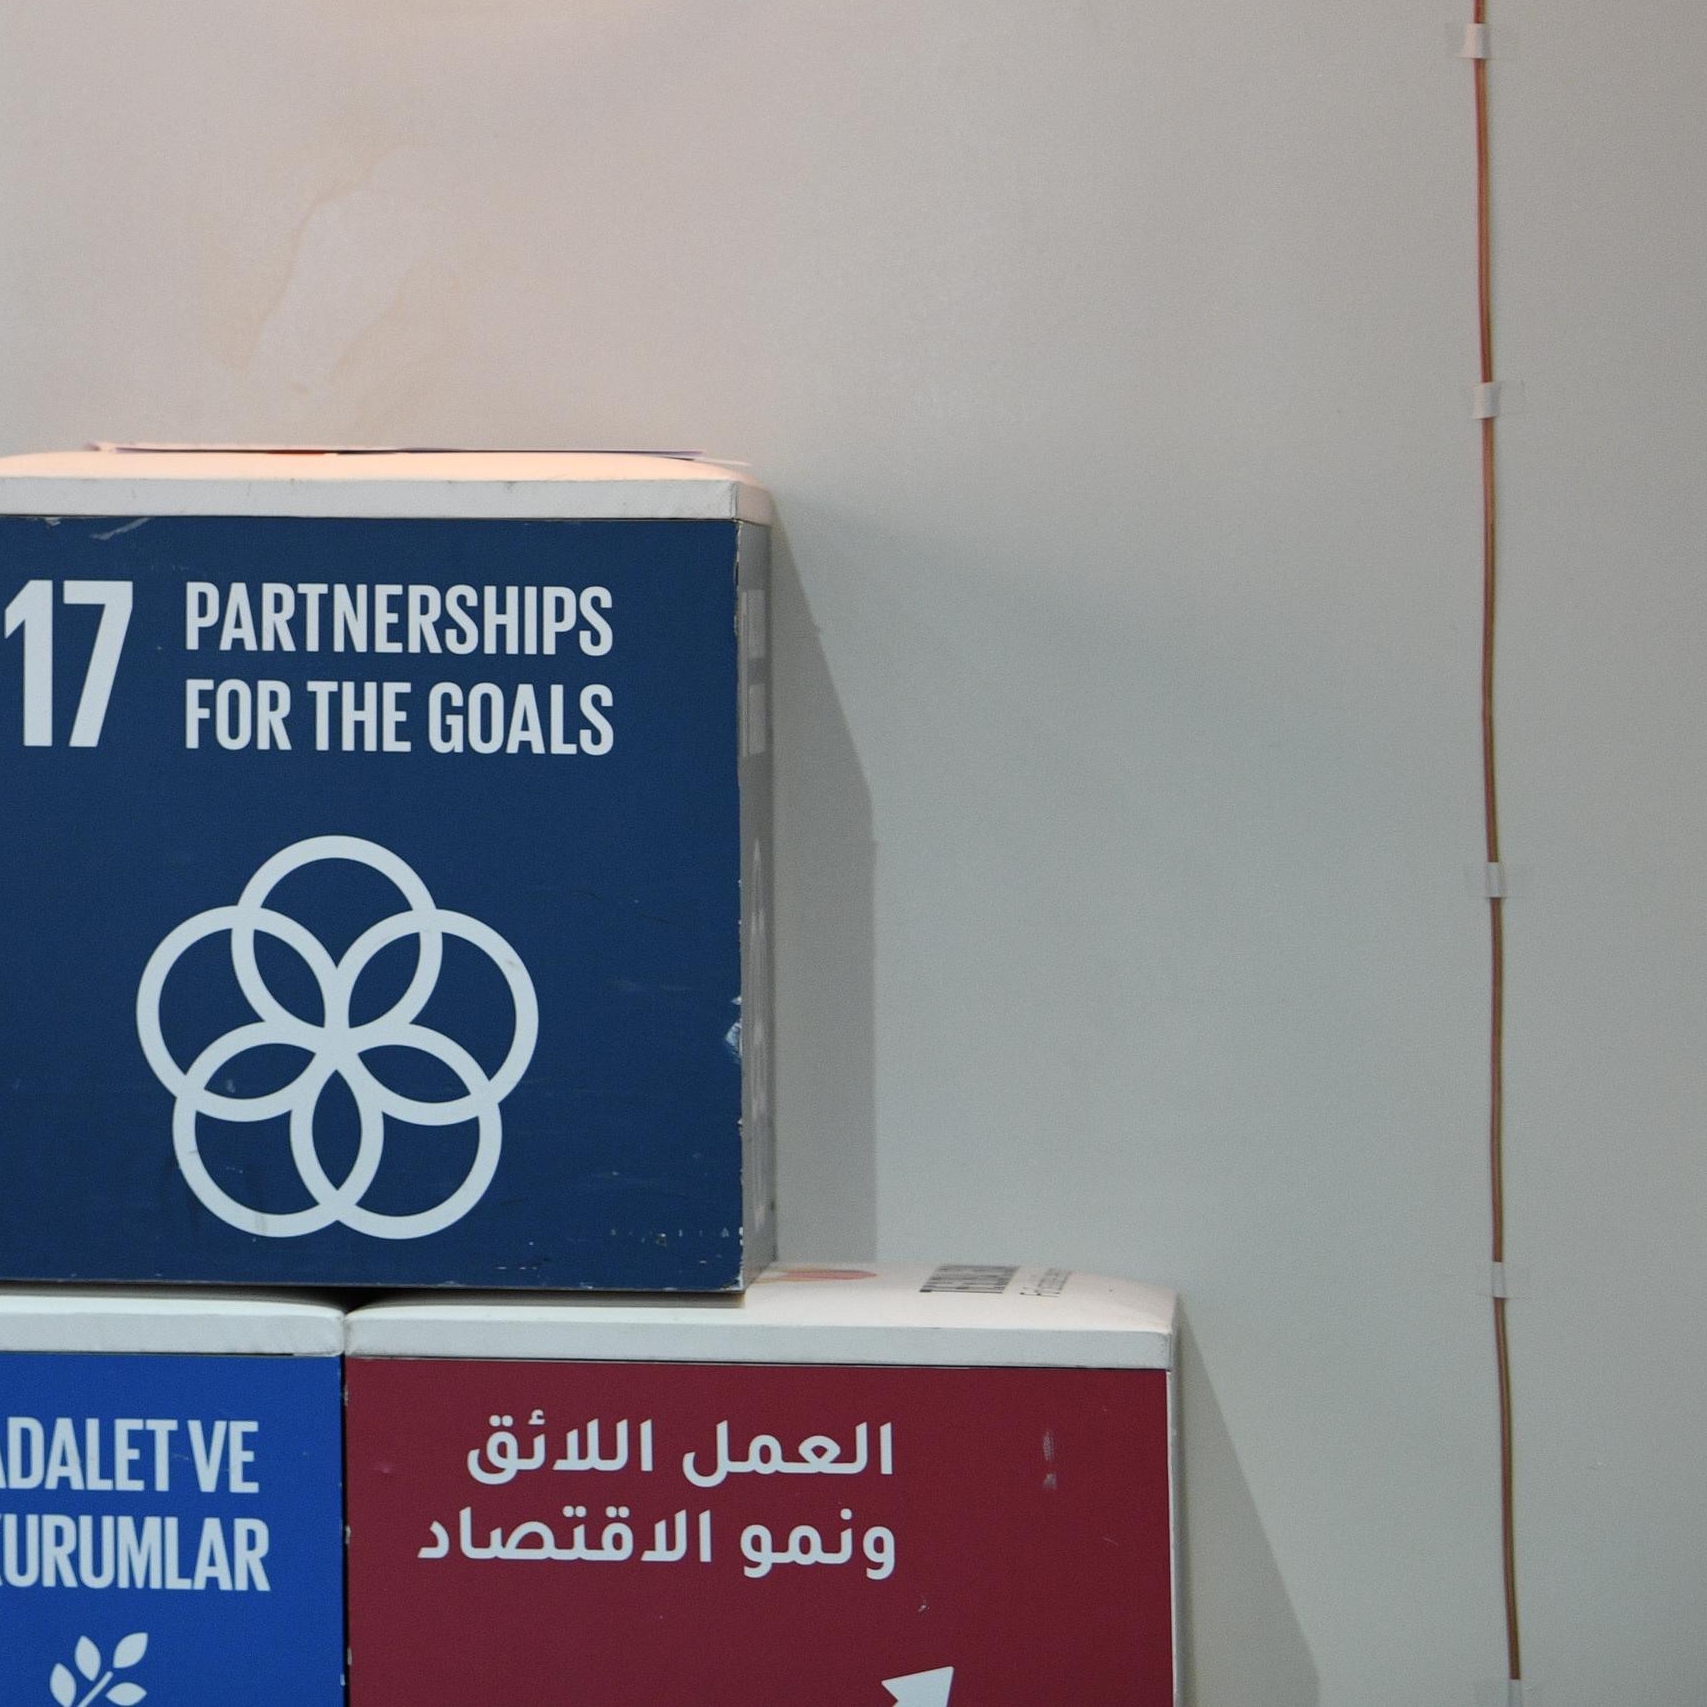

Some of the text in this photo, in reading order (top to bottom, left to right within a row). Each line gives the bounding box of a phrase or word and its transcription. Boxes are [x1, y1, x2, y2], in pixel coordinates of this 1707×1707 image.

[186, 581, 614, 657] PARTNERSHIPS
[3, 579, 134, 748] 17
[186, 679, 614, 756] FOR THE GOALS
[188, 1420, 260, 1494] VE
[466, 1409, 896, 1490] العمل اللائق
[417, 1505, 897, 1582] ونمو الاقتصاد
